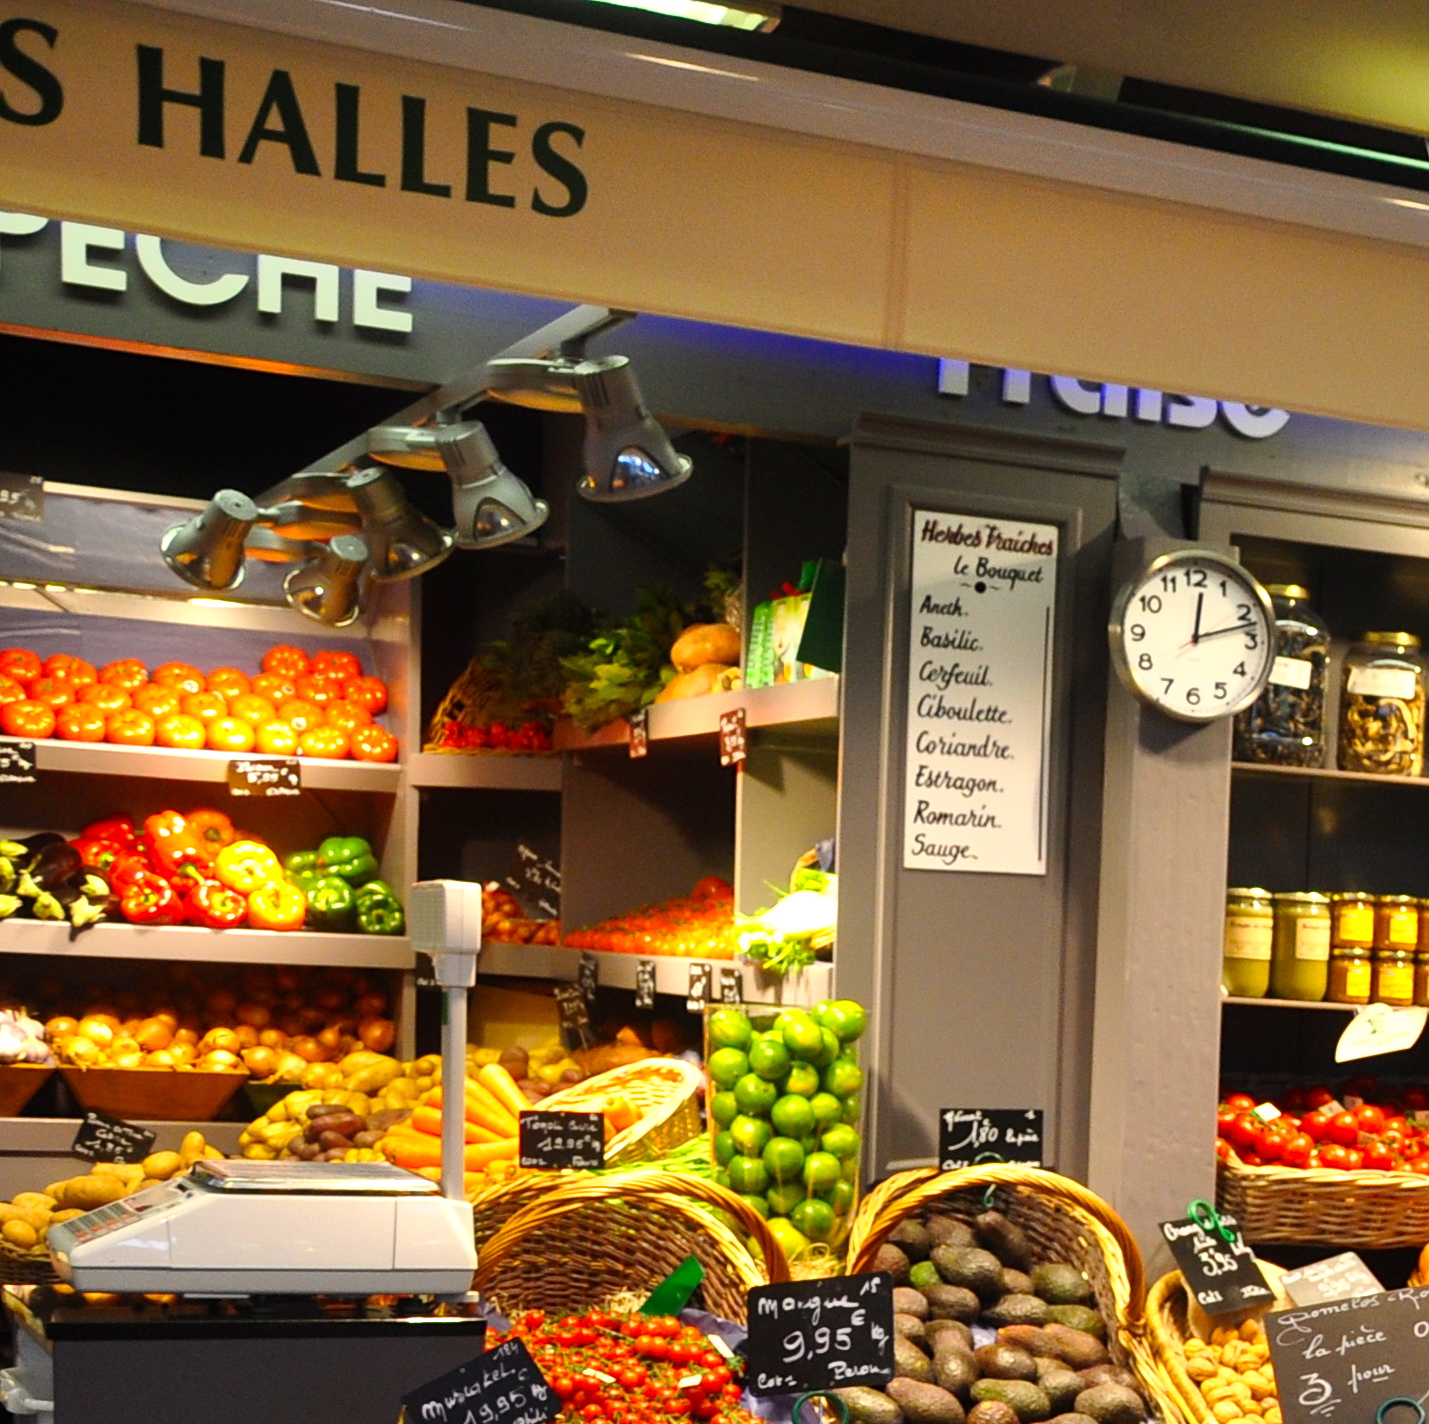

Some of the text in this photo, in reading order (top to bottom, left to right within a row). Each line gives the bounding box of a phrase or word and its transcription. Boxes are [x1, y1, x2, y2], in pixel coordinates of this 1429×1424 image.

[0, 18, 588, 218] S HALLES
[921, 519, 981, 548] Herbes
[976, 557, 1043, 591] Bouquet
[1184, 569, 1208, 588] 12
[1161, 575, 1177, 593] 11
[1219, 580, 1227, 597] 1
[1139, 594, 1163, 614] 10
[1237, 604, 1252, 621] 2
[1131, 623, 1146, 642] 9
[1138, 653, 1153, 671] 8
[1232, 661, 1247, 677] 4
[1160, 677, 1174, 695] 7
[1213, 682, 1227, 700] 5
[1186, 687, 1201, 705] 6
[783, 1327, 852, 1363] 9,95
[1298, 1372, 1334, 1406] 3
[1347, 1363, 1395, 1394] pour
